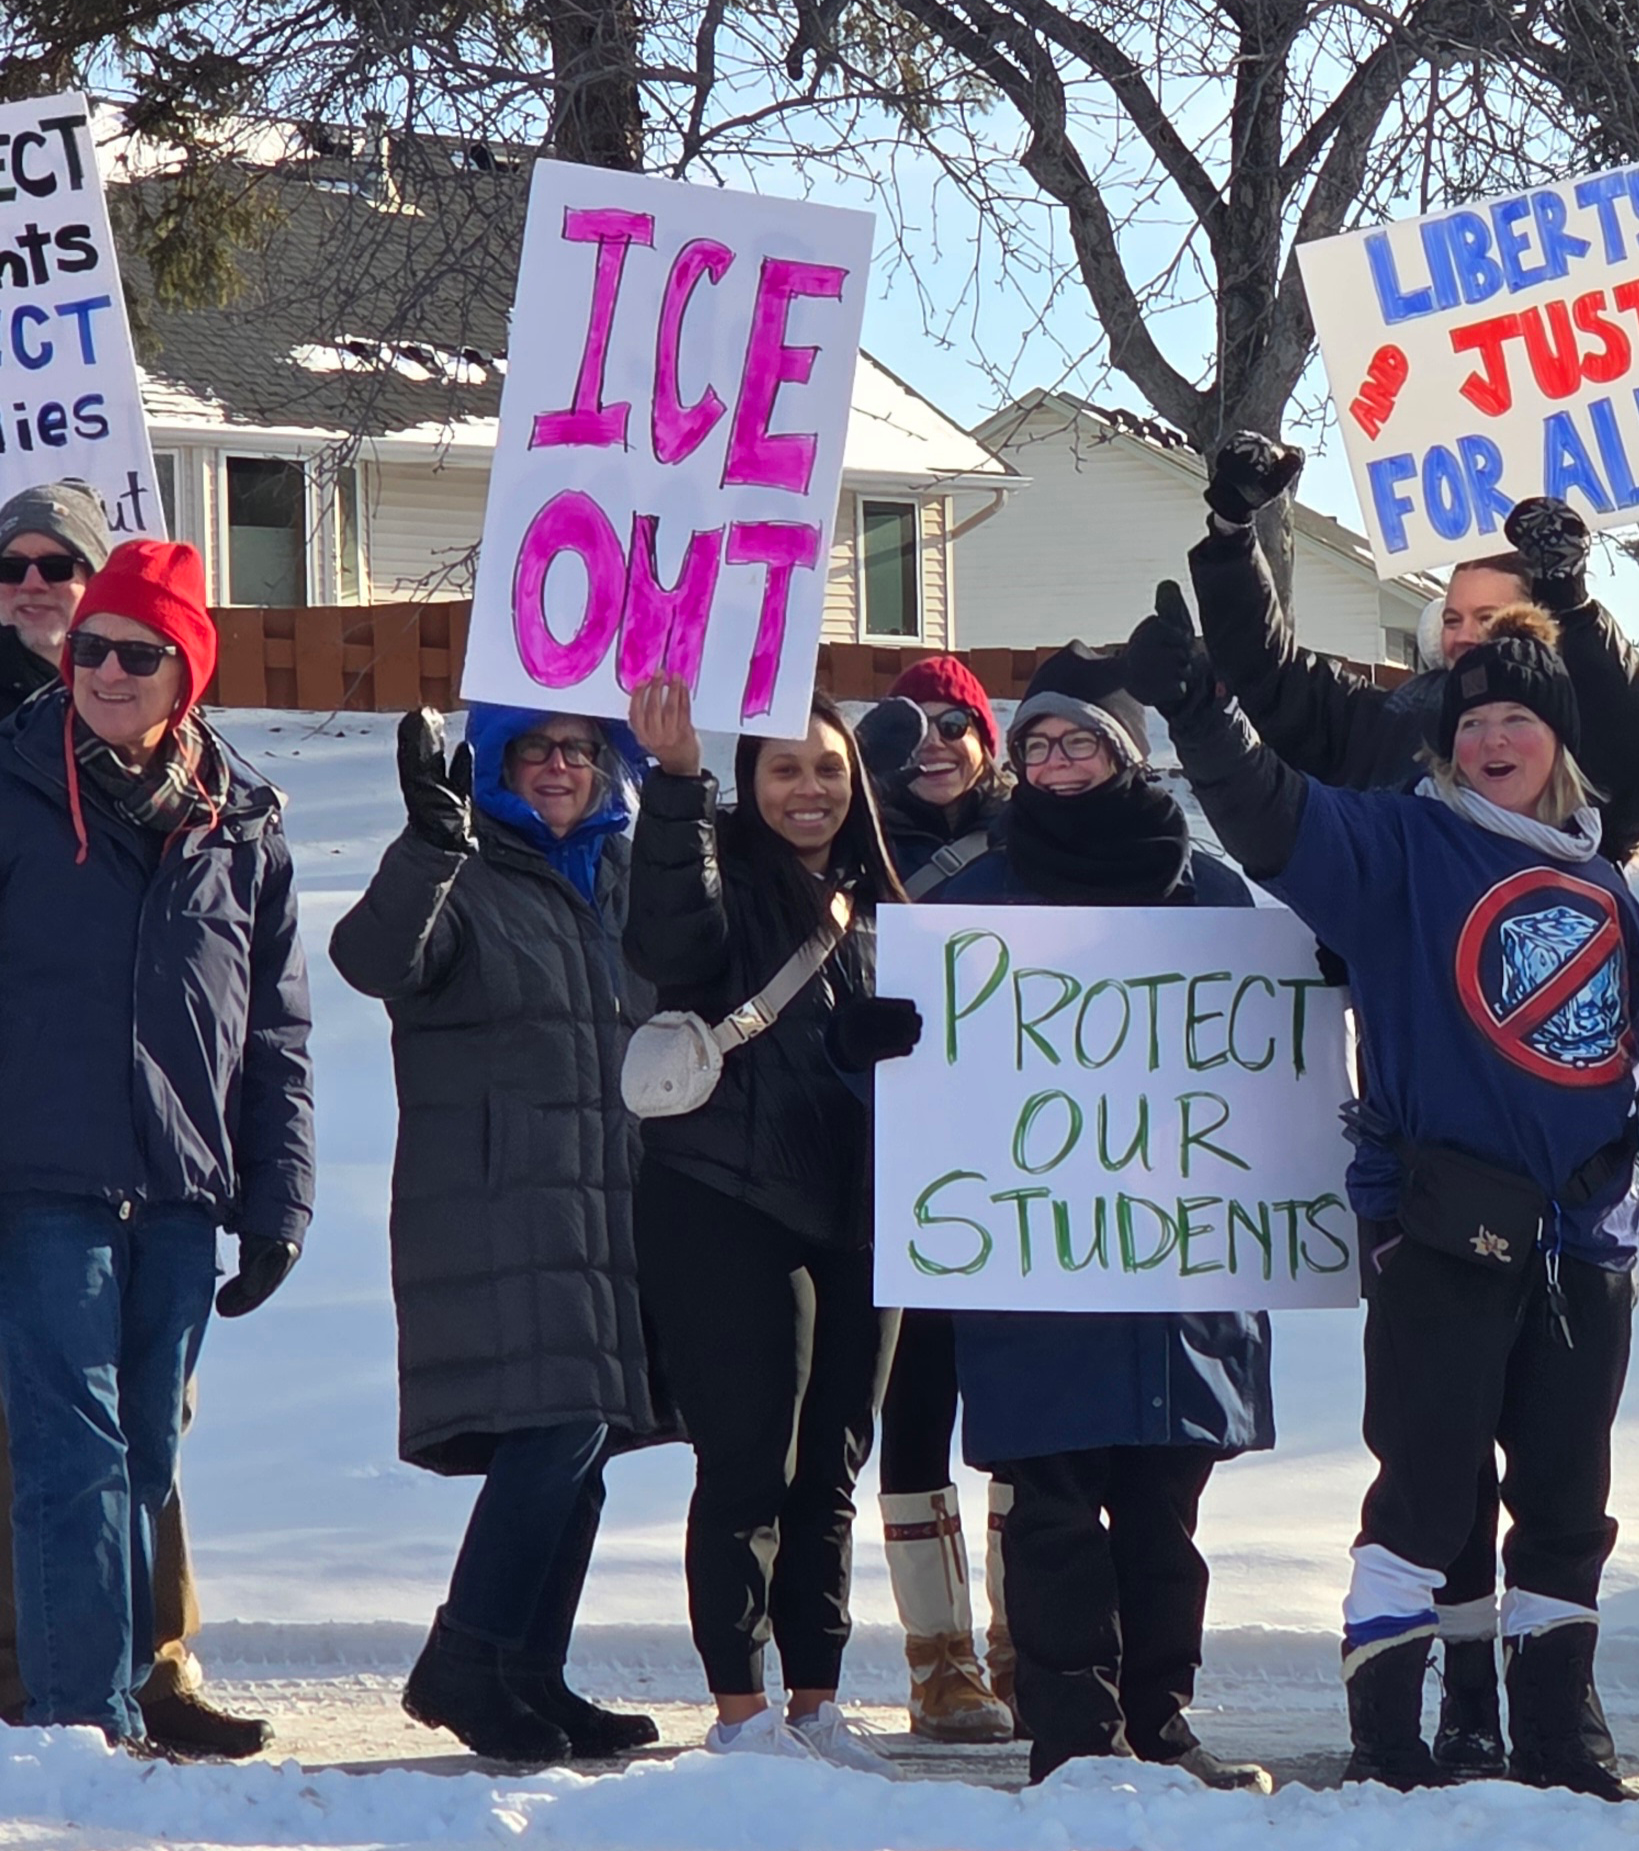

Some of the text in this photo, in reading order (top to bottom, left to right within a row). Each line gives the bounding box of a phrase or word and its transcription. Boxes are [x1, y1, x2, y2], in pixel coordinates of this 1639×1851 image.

[0, 295, 111, 370] CT
[528, 205, 850, 495] ICE
[0, 394, 109, 453] ies
[1349, 343, 1410, 442] AND
[1366, 433, 1516, 555] FOR
[511, 488, 823, 726] OUT
[944, 928, 1345, 1081] PROTECT
[1012, 1089, 1252, 1179] OUR
[908, 1169, 1350, 1281] STUDENTS
